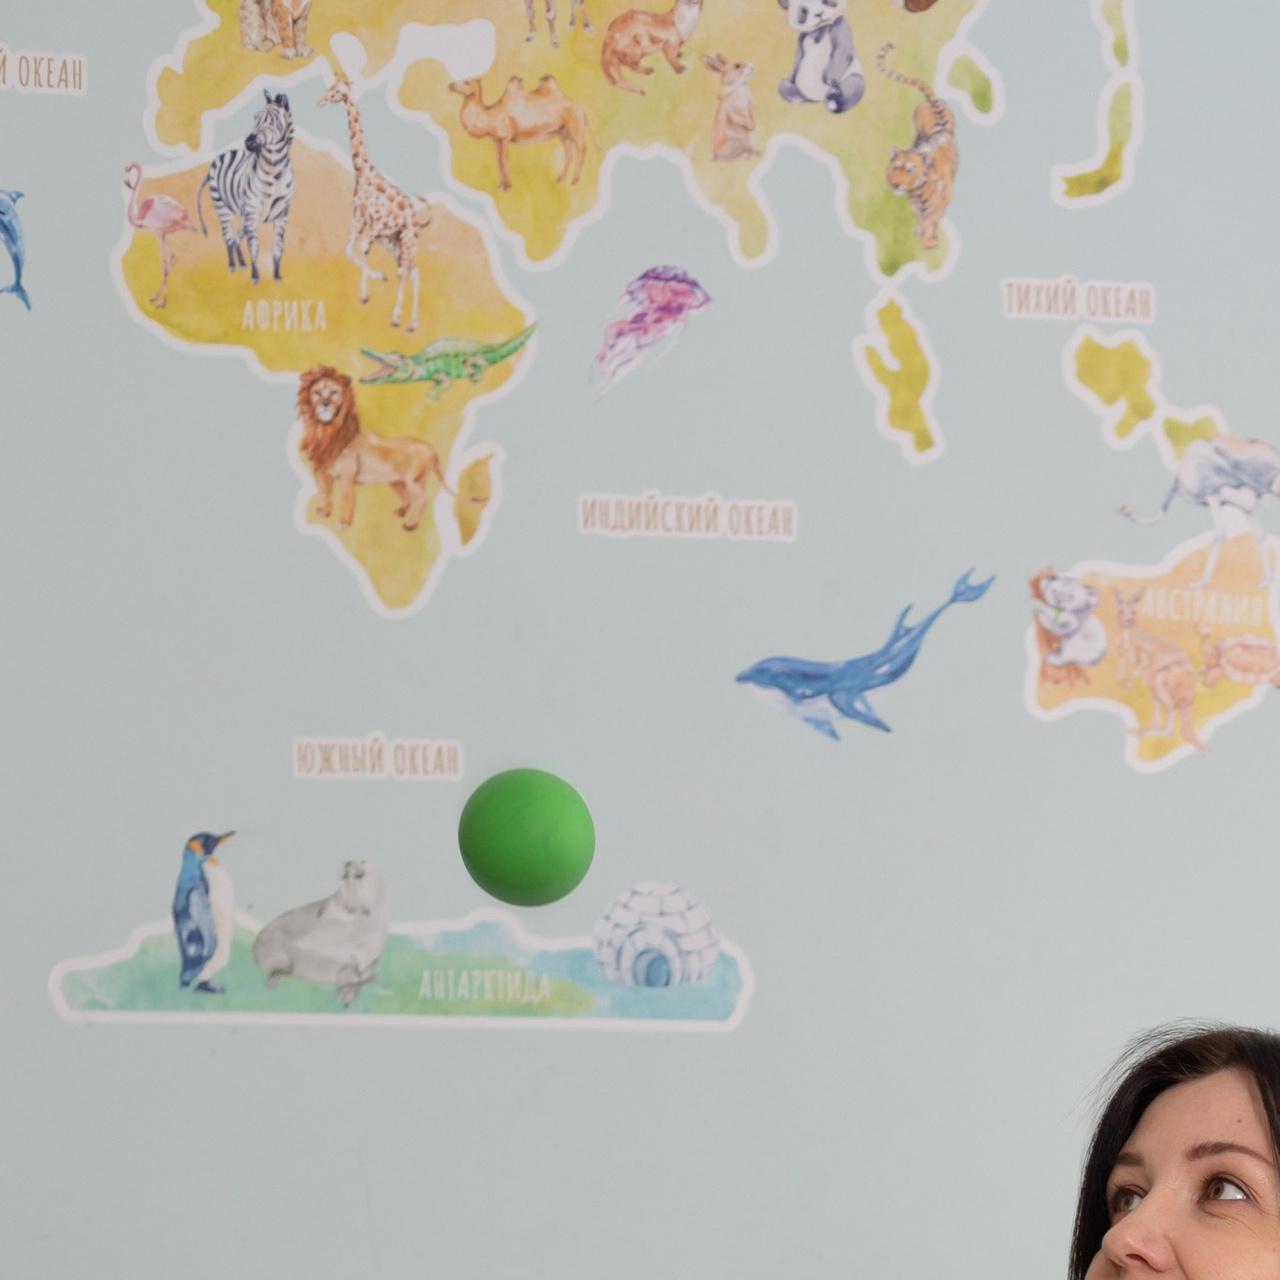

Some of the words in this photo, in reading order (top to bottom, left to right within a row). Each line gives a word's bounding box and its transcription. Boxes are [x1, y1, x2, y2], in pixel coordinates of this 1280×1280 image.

[18, 55, 82, 90] ОКЕАН
[241, 298, 327, 332] АФРИКА
[1005, 278, 1077, 314] ТИХИЙ
[1086, 285, 1152, 318] ОКЕАН
[581, 494, 720, 533] ИНДИЙСКИЙ
[728, 502, 794, 536] ОКЕАН
[297, 737, 384, 775] ЮЖНЫЙ
[393, 743, 459, 776] ОКЕАН
[417, 968, 550, 1004] АНТАРКТИДА
